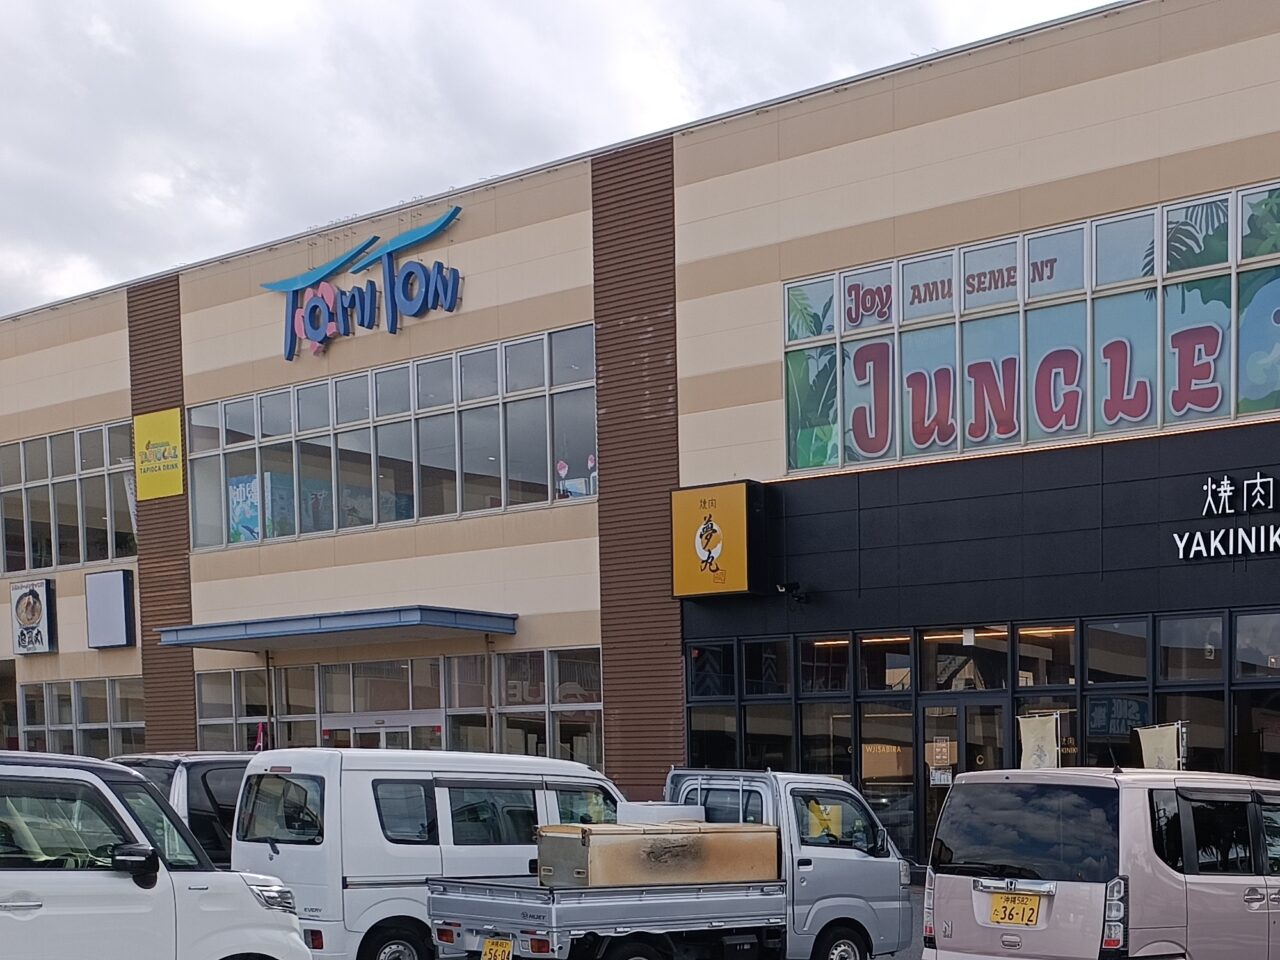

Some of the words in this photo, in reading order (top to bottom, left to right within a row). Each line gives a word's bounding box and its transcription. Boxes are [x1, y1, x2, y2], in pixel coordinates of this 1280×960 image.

[909, 258, 1058, 306] AMUSEMENT
[850, 324, 1223, 457] JUNGLE
[1202, 471, 1275, 517] 焼肉
[699, 513, 720, 573] 夢丸
[1000, 905, 1035, 923] 36-12
